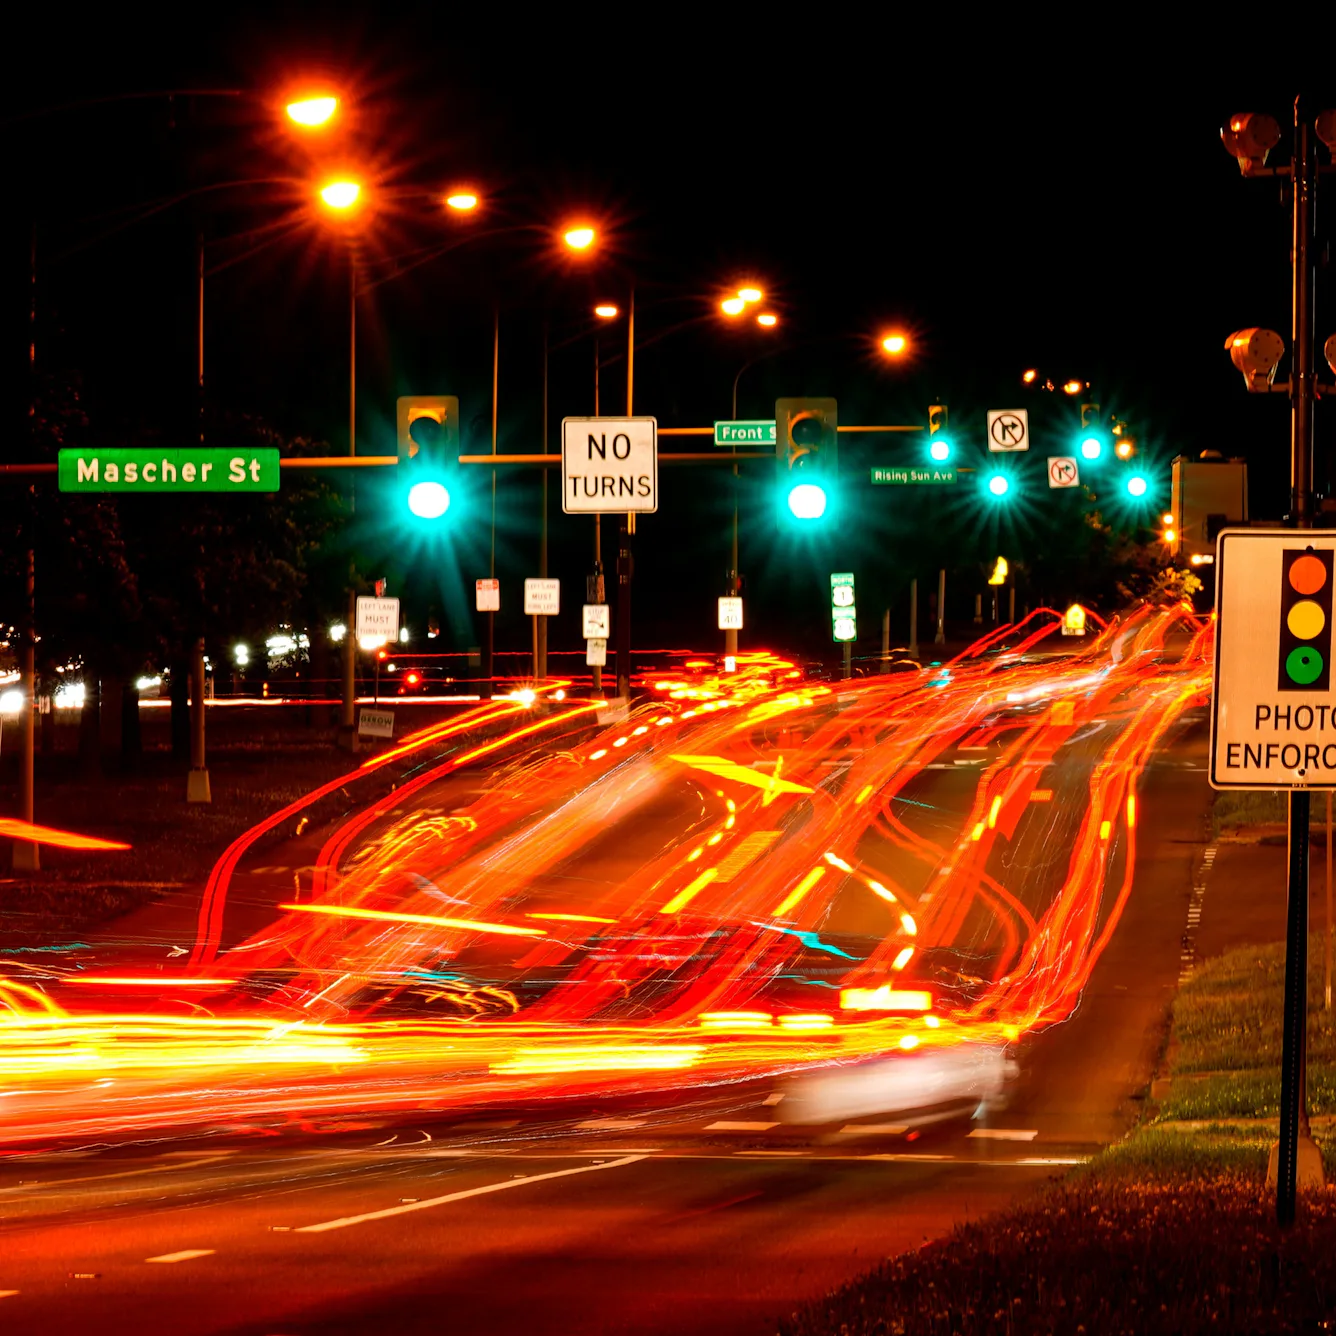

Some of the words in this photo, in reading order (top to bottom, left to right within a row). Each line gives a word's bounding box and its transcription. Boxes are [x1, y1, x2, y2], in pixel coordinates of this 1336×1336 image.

[722, 426, 763, 440] Front
[769, 426, 777, 440] S
[587, 432, 631, 461] NO
[77, 457, 213, 483] Mascher
[228, 457, 261, 483] St
[874, 469, 908, 484] Rising
[910, 470, 931, 481] Sun
[933, 470, 953, 481] Ave
[568, 475, 651, 498] TURNS
[531, 592, 552, 600] MUST
[360, 603, 376, 611] LEFT
[378, 603, 396, 611] LANE
[365, 614, 390, 624] MUST
